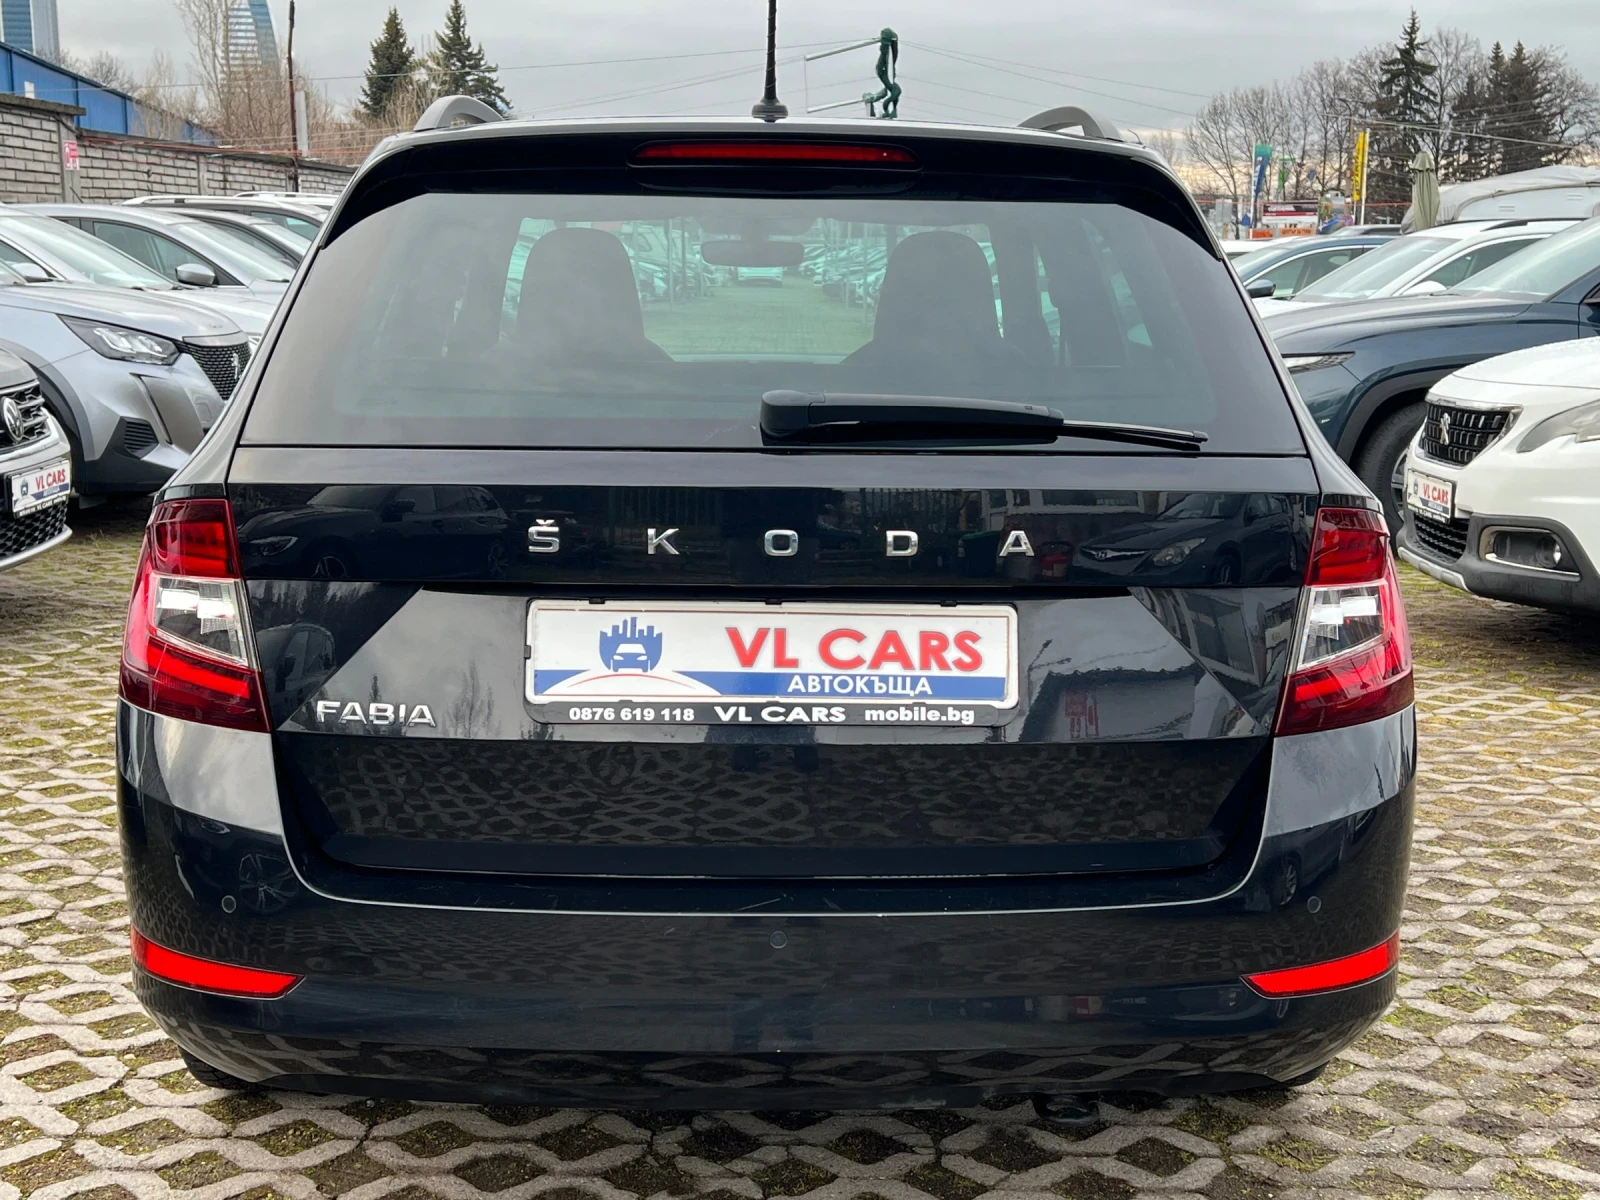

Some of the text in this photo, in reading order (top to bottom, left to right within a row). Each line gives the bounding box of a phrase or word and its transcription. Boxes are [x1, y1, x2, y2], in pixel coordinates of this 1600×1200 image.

[46, 468, 66, 487] CARS
[528, 519, 1035, 557] ŠKODA
[725, 627, 983, 672] VL CARS
[787, 675, 933, 697] АВТОКЪЩА
[315, 700, 437, 727] FABIA
[569, 706, 975, 724] 0876 619 118 VL CARS mobile.bg
